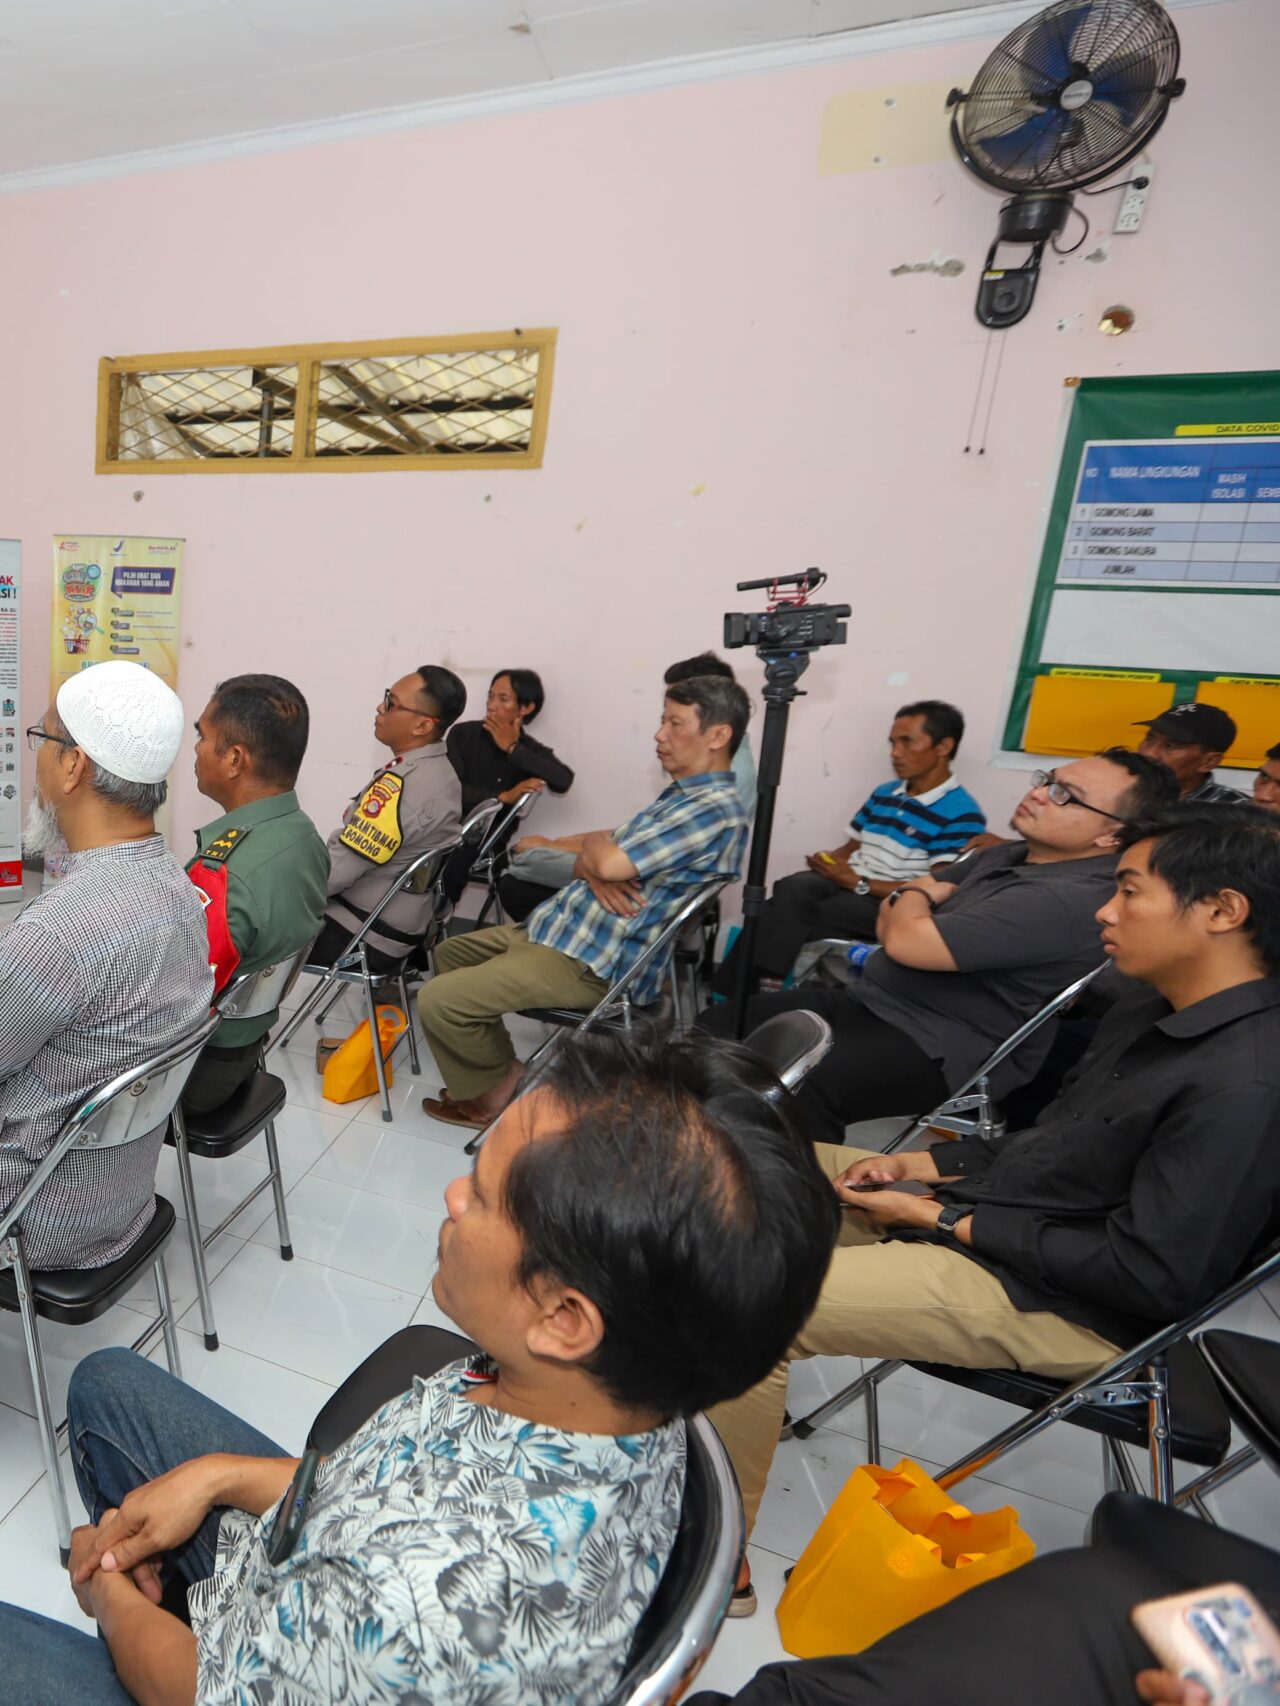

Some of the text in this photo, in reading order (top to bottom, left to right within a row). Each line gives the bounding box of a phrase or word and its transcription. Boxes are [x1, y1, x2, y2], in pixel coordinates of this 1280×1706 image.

[1217, 424, 1280, 433] DATA COVID
[1109, 466, 1138, 478] NAMA
[1139, 466, 1201, 478] LINGKUNGAN
[1217, 473, 1248, 483] MASIH
[1210, 488, 1247, 498] ISOLASI
[205, 849, 224, 857] TNI
